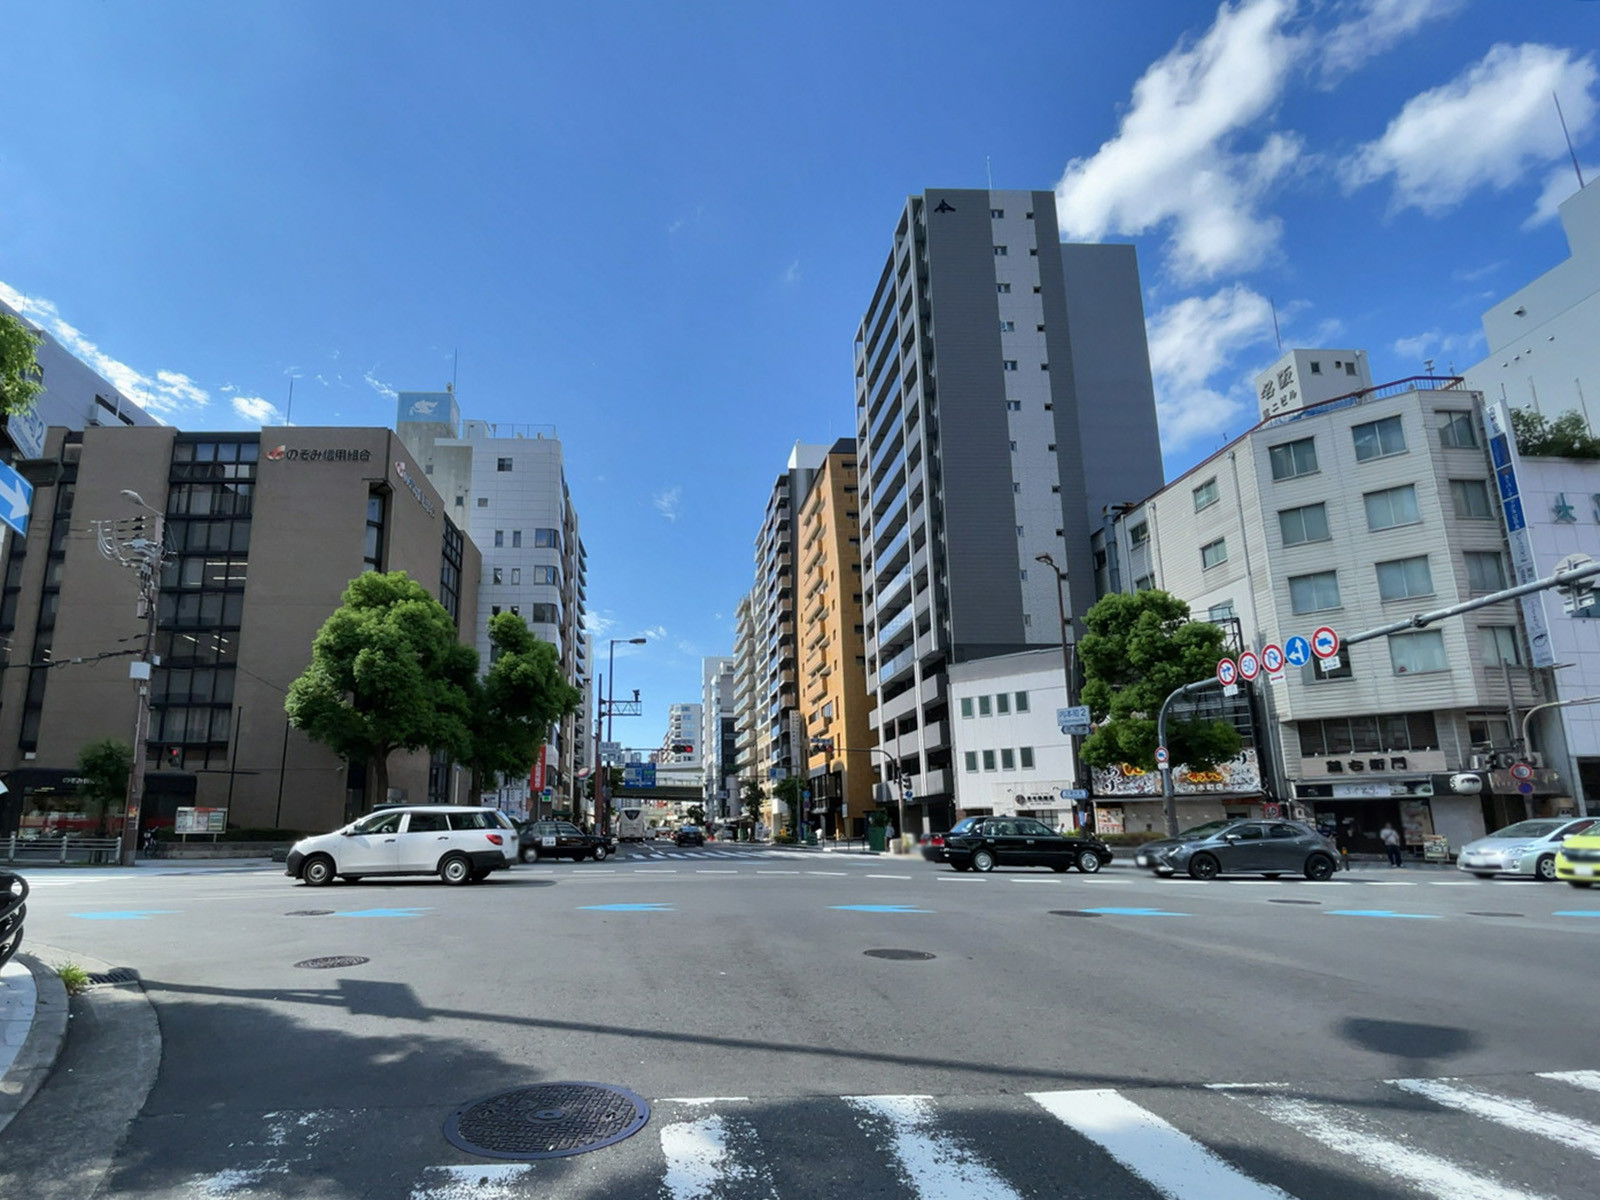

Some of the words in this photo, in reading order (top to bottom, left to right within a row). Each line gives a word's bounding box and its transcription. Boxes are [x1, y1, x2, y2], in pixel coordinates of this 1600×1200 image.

[287, 449, 371, 461] のぞみ信用組合
